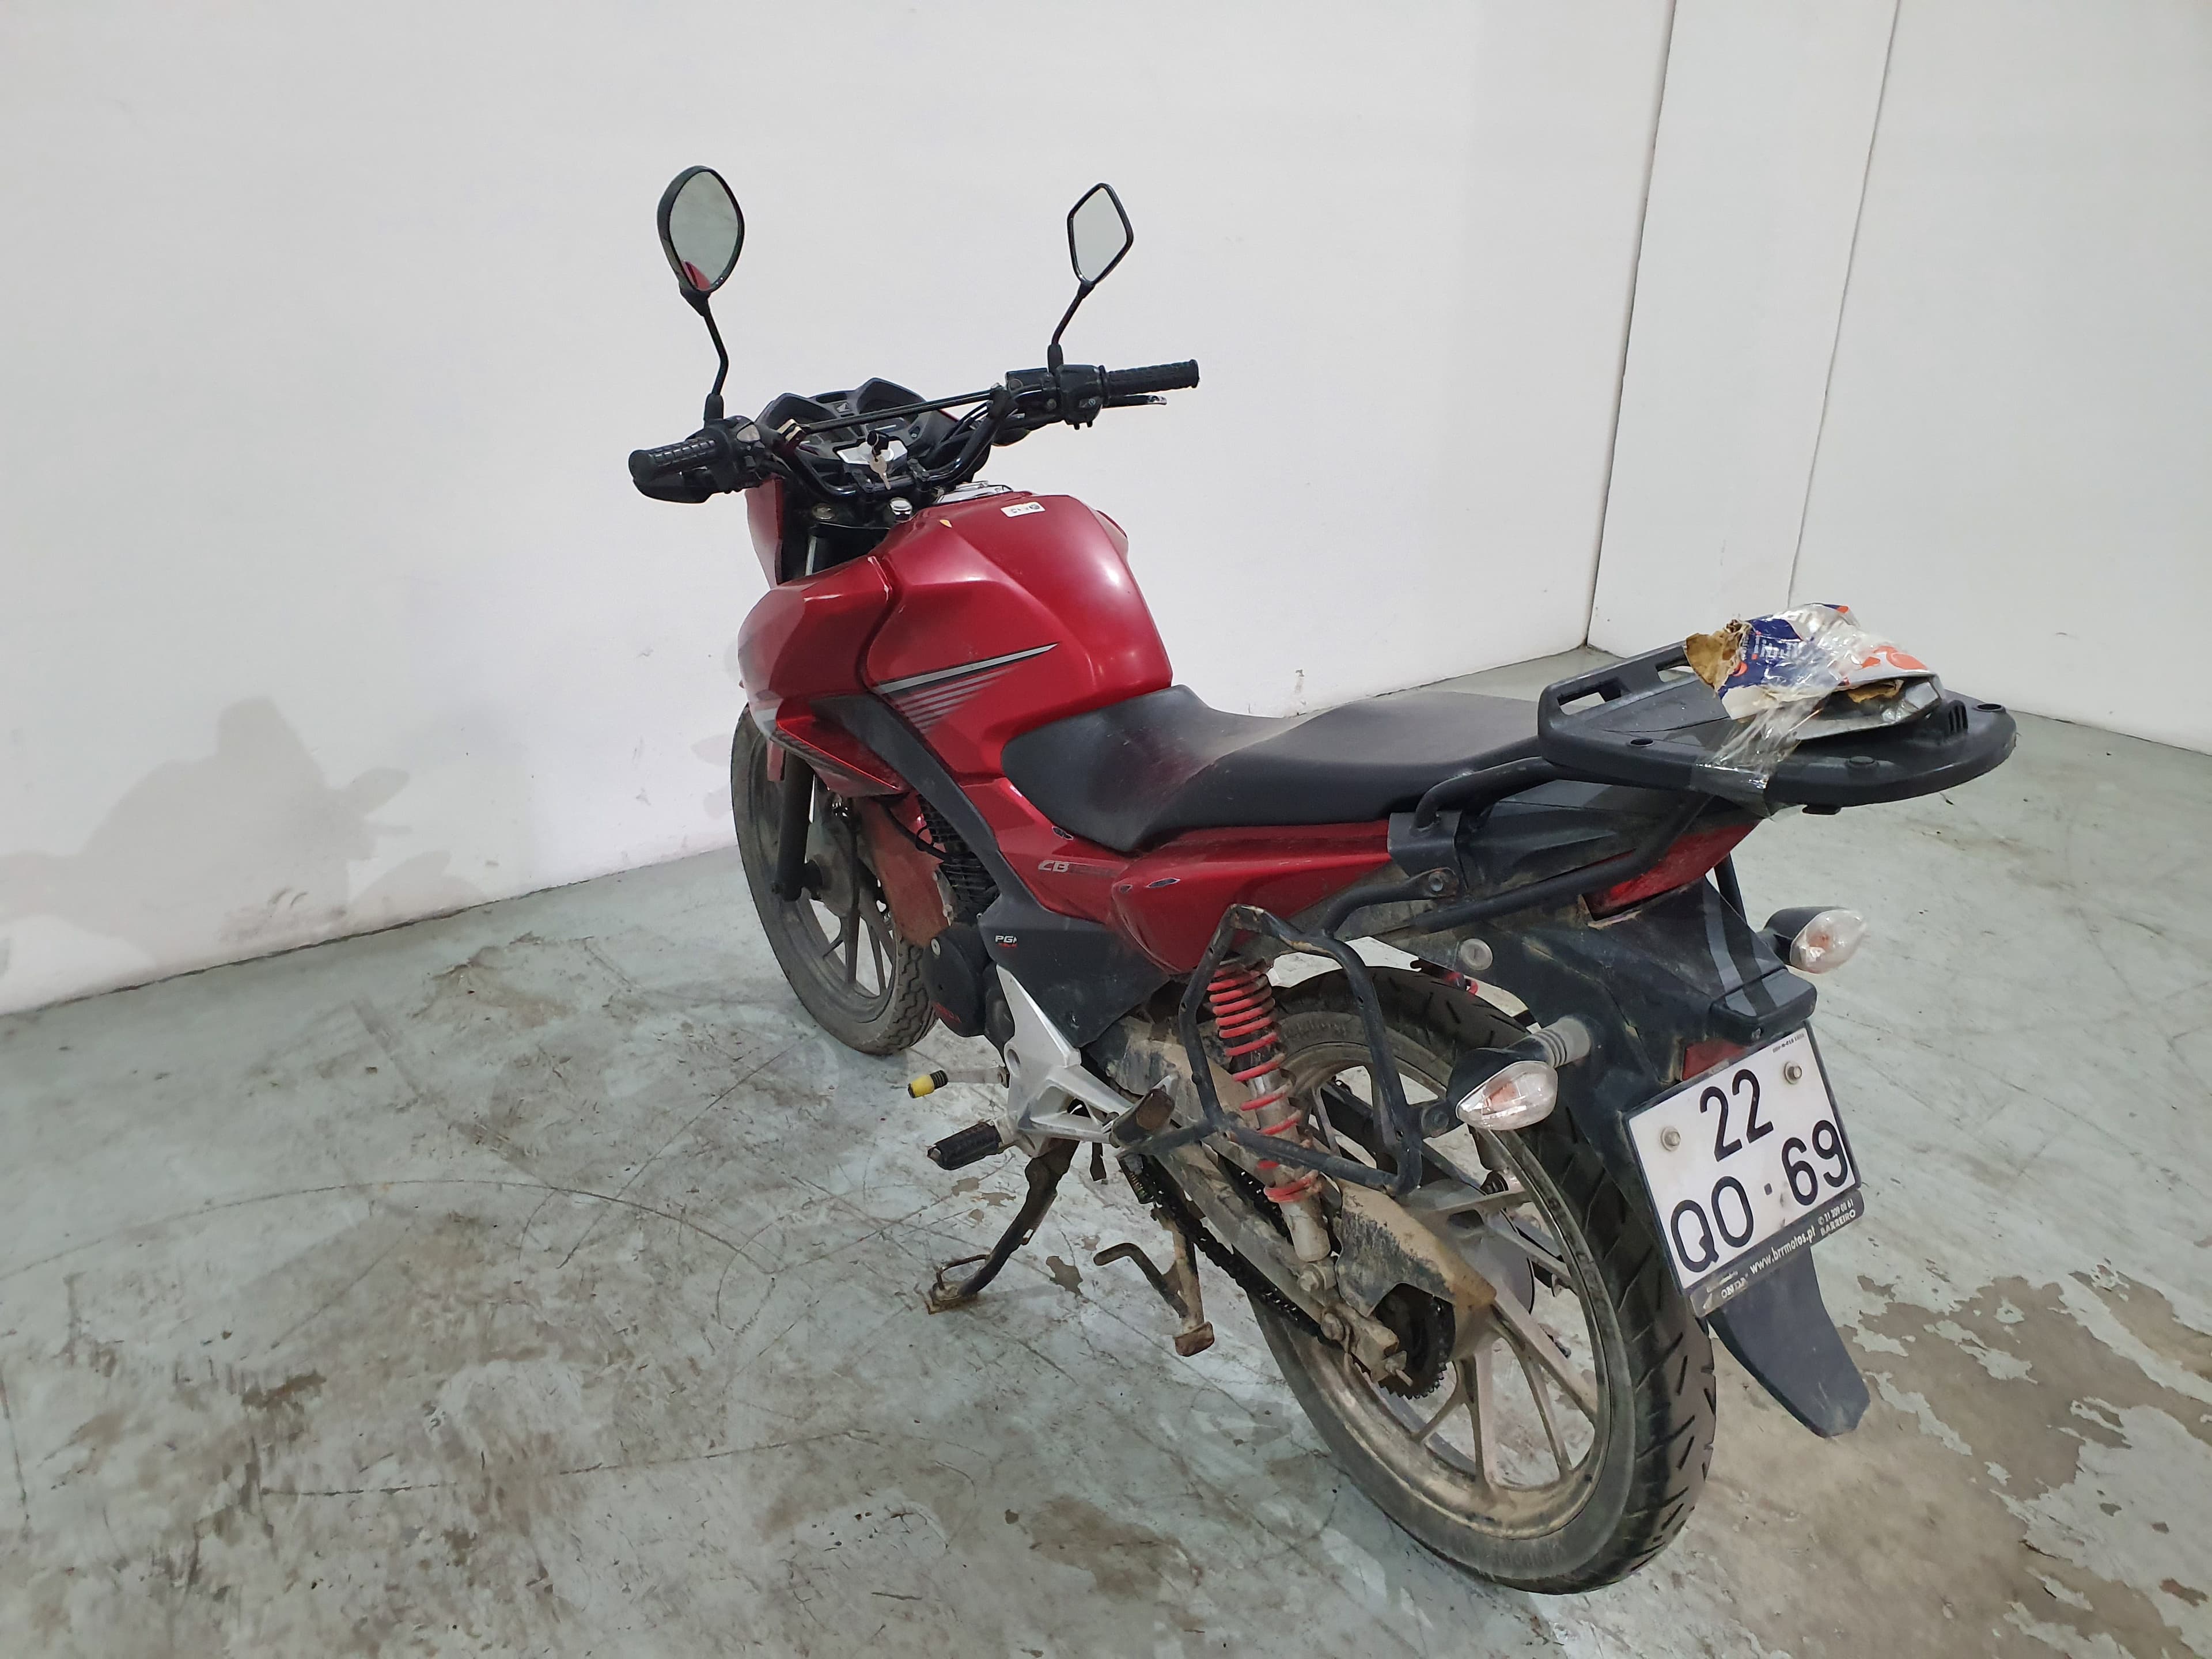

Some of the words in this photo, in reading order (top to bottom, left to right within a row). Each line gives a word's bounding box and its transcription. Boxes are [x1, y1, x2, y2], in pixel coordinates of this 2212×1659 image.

[1037, 859, 1070, 873] CB
[1699, 1069, 1774, 1162] 22
[1820, 1209, 1856, 1237] BARREIRO
[1749, 1225, 1816, 1275] www.brrmotos.pt
